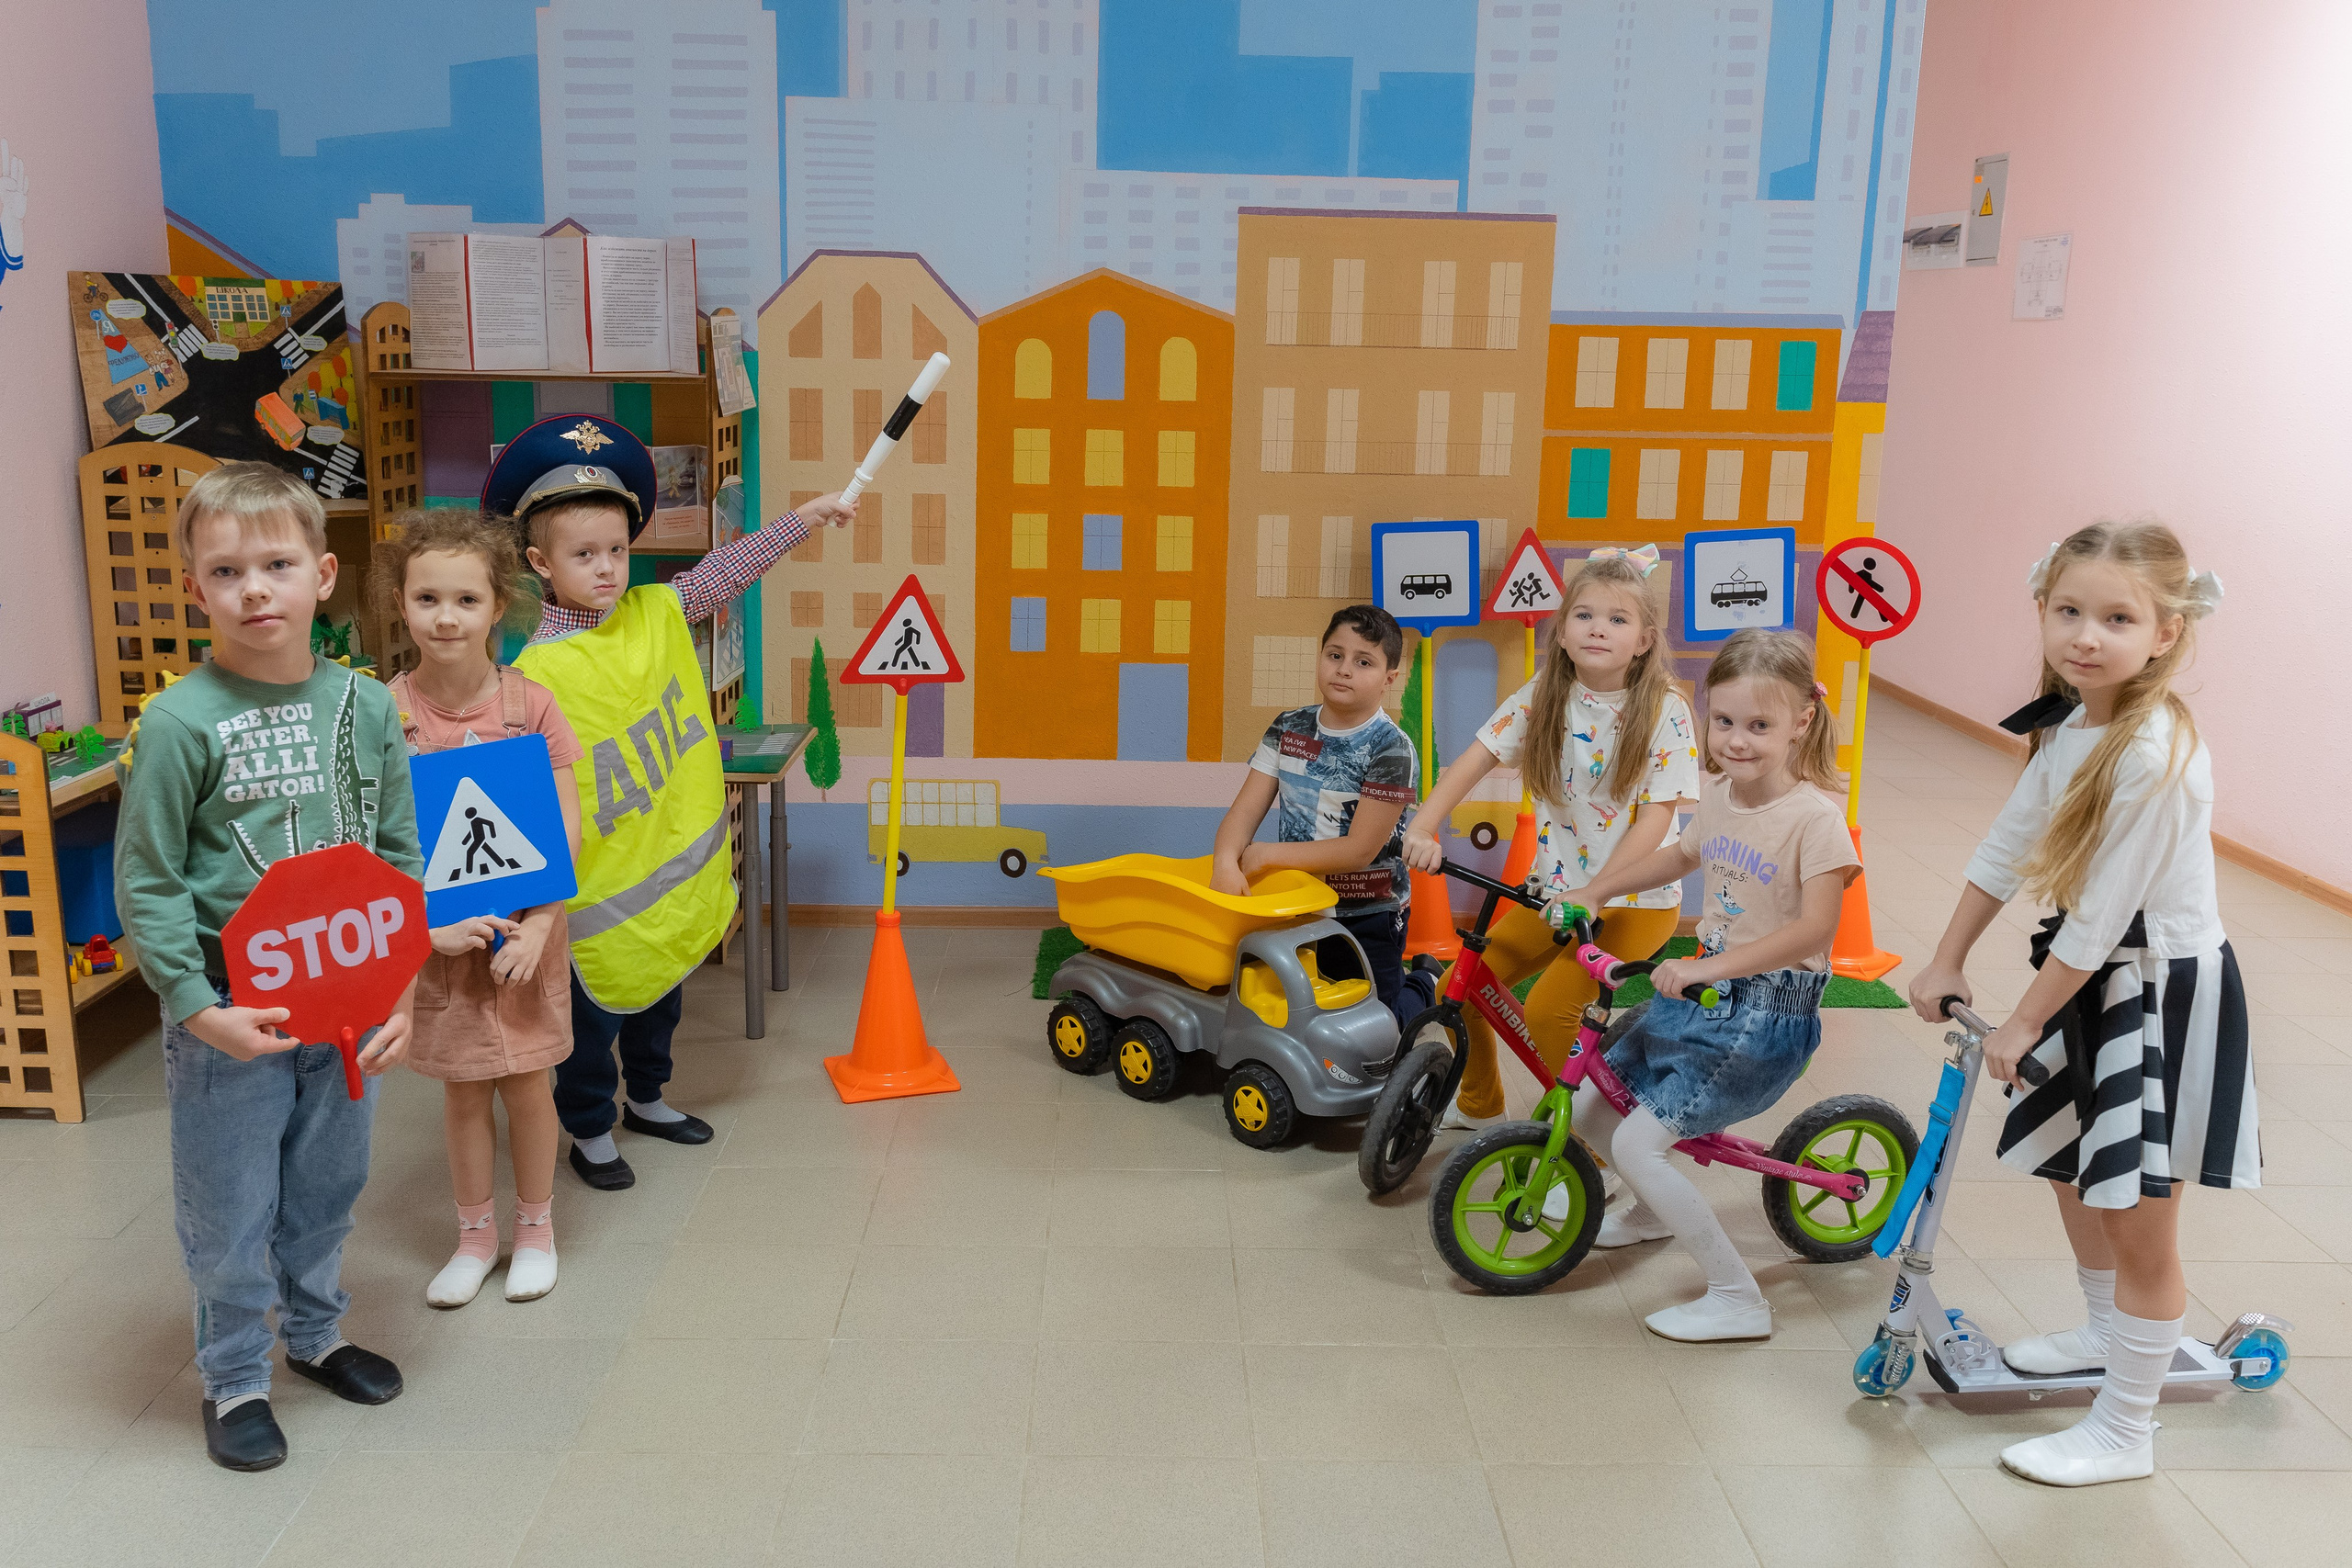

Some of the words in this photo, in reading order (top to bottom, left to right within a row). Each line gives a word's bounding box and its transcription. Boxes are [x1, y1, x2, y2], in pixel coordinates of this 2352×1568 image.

[102, 320, 116, 333] Я
[217, 708, 263, 739] SEE
[264, 703, 313, 725] YOU
[222, 724, 319, 755] LATER,
[223, 745, 320, 783] ALLI
[593, 673, 709, 838] ДПС
[224, 773, 325, 803] GATOR!
[1369, 788, 1387, 796] IDEA
[1369, 872, 1390, 880] AWAY
[1702, 835, 1779, 886] MORNING
[1712, 863, 1748, 883] RITUALS:
[246, 897, 405, 991] STOP
[1479, 983, 1535, 1052] RUNBIKE
[1756, 1162, 1784, 1175] Vintage
[1784, 1168, 1804, 1180] style
